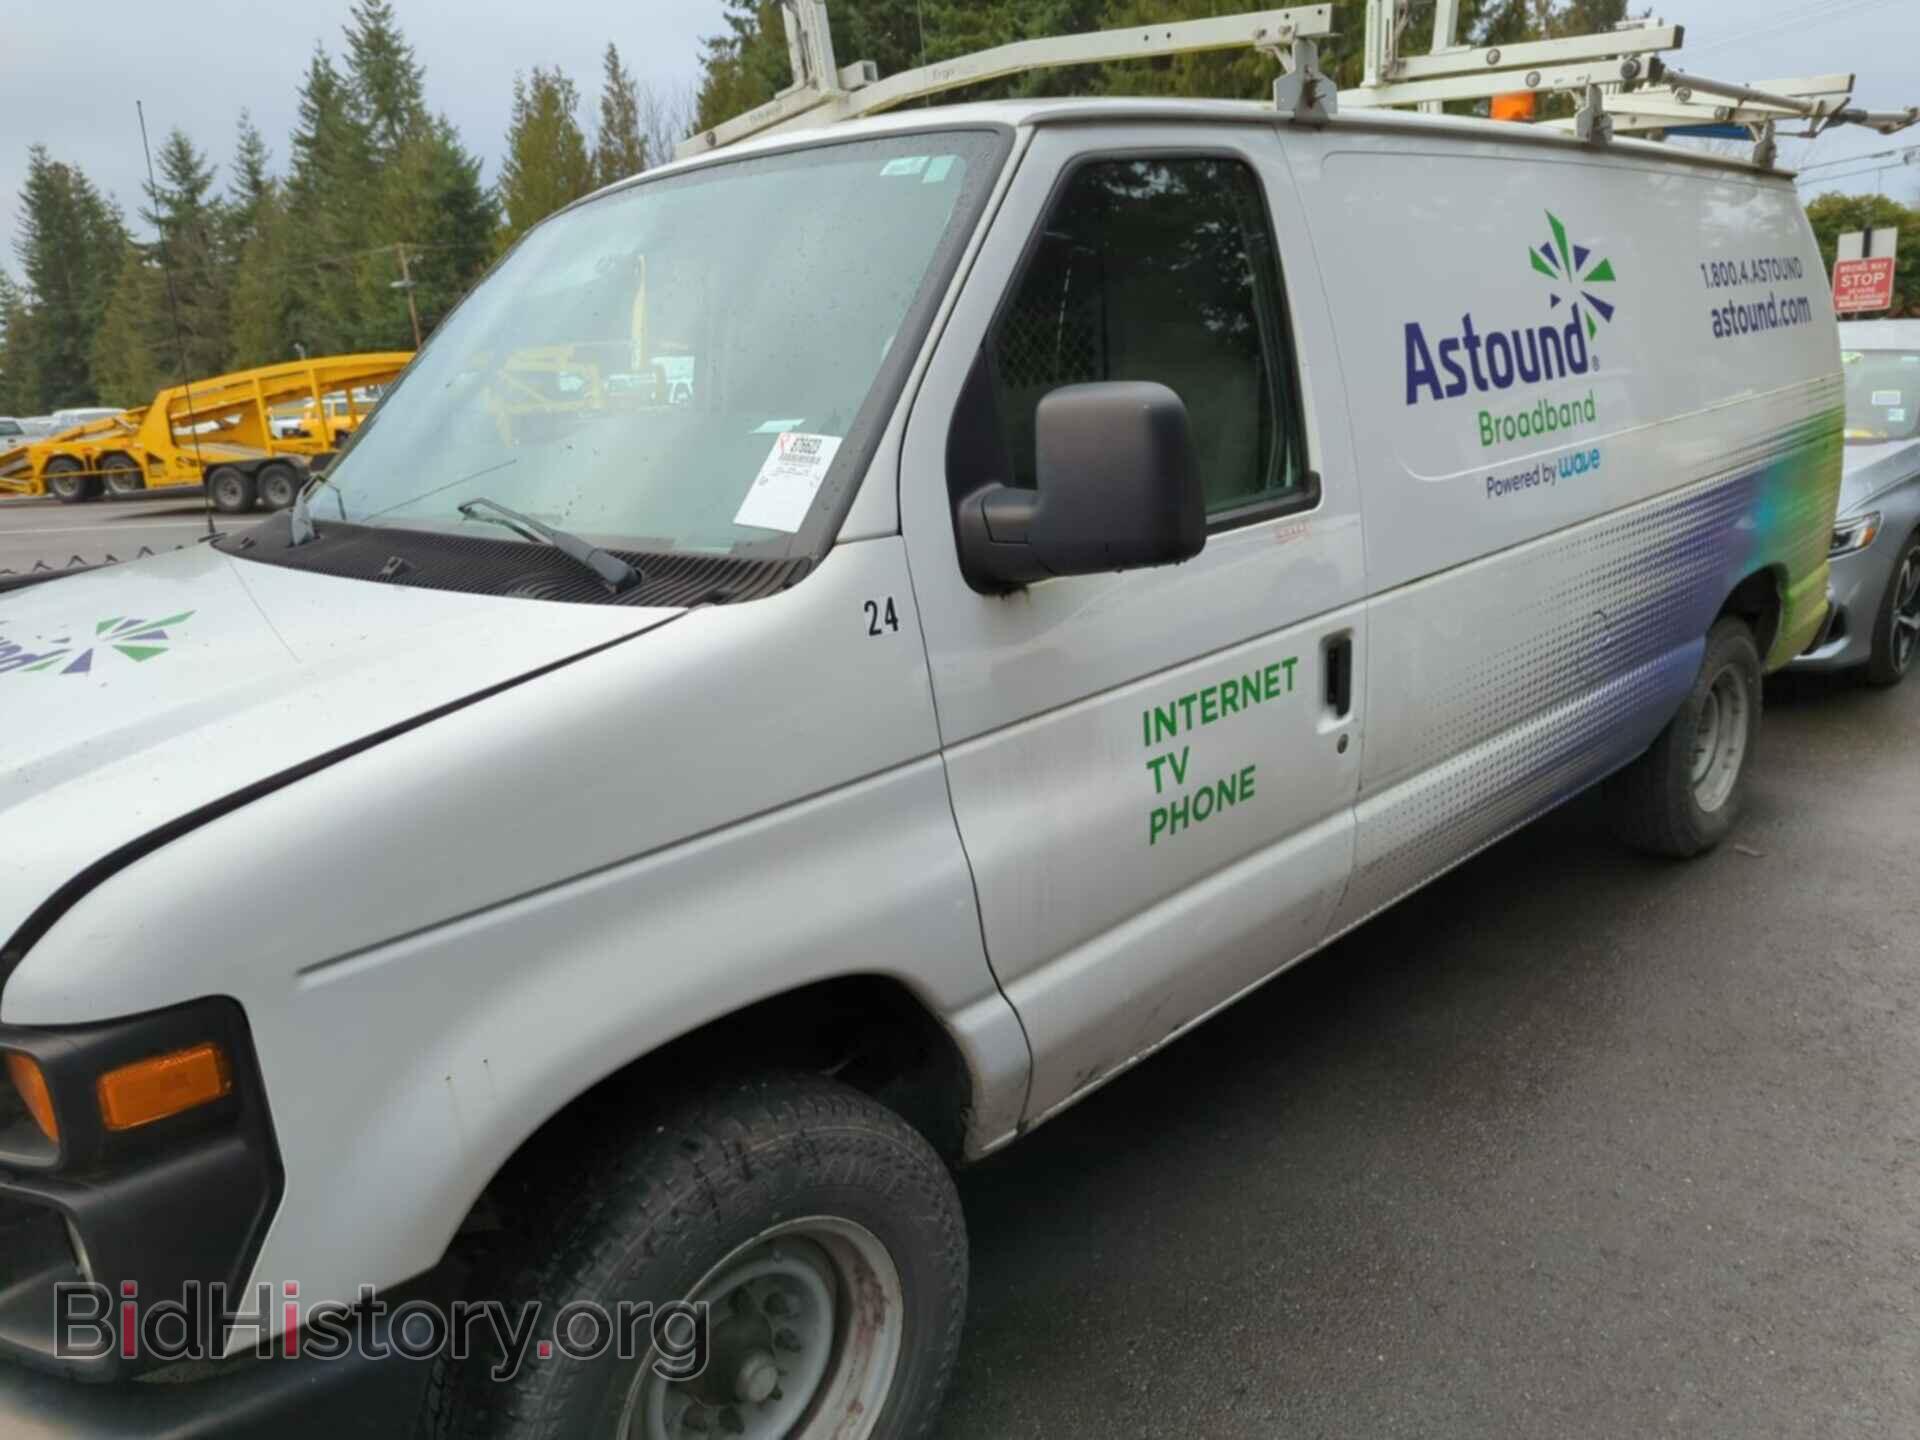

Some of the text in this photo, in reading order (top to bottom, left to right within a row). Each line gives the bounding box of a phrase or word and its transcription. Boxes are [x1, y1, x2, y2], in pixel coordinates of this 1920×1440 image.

[1701, 257, 1803, 289] 1.800.4.ASTOUND
[1841, 272, 1885, 287] STOP
[1711, 291, 1812, 338] astound.com
[1404, 302, 1588, 405] Astound
[1479, 389, 1596, 447] Broadband
[1486, 448, 1600, 499] Powered by wave
[864, 596, 899, 636] 24
[1143, 656, 1298, 747] INTERNET
[1146, 746, 1189, 794] TV
[1150, 765, 1256, 846] PHONE
